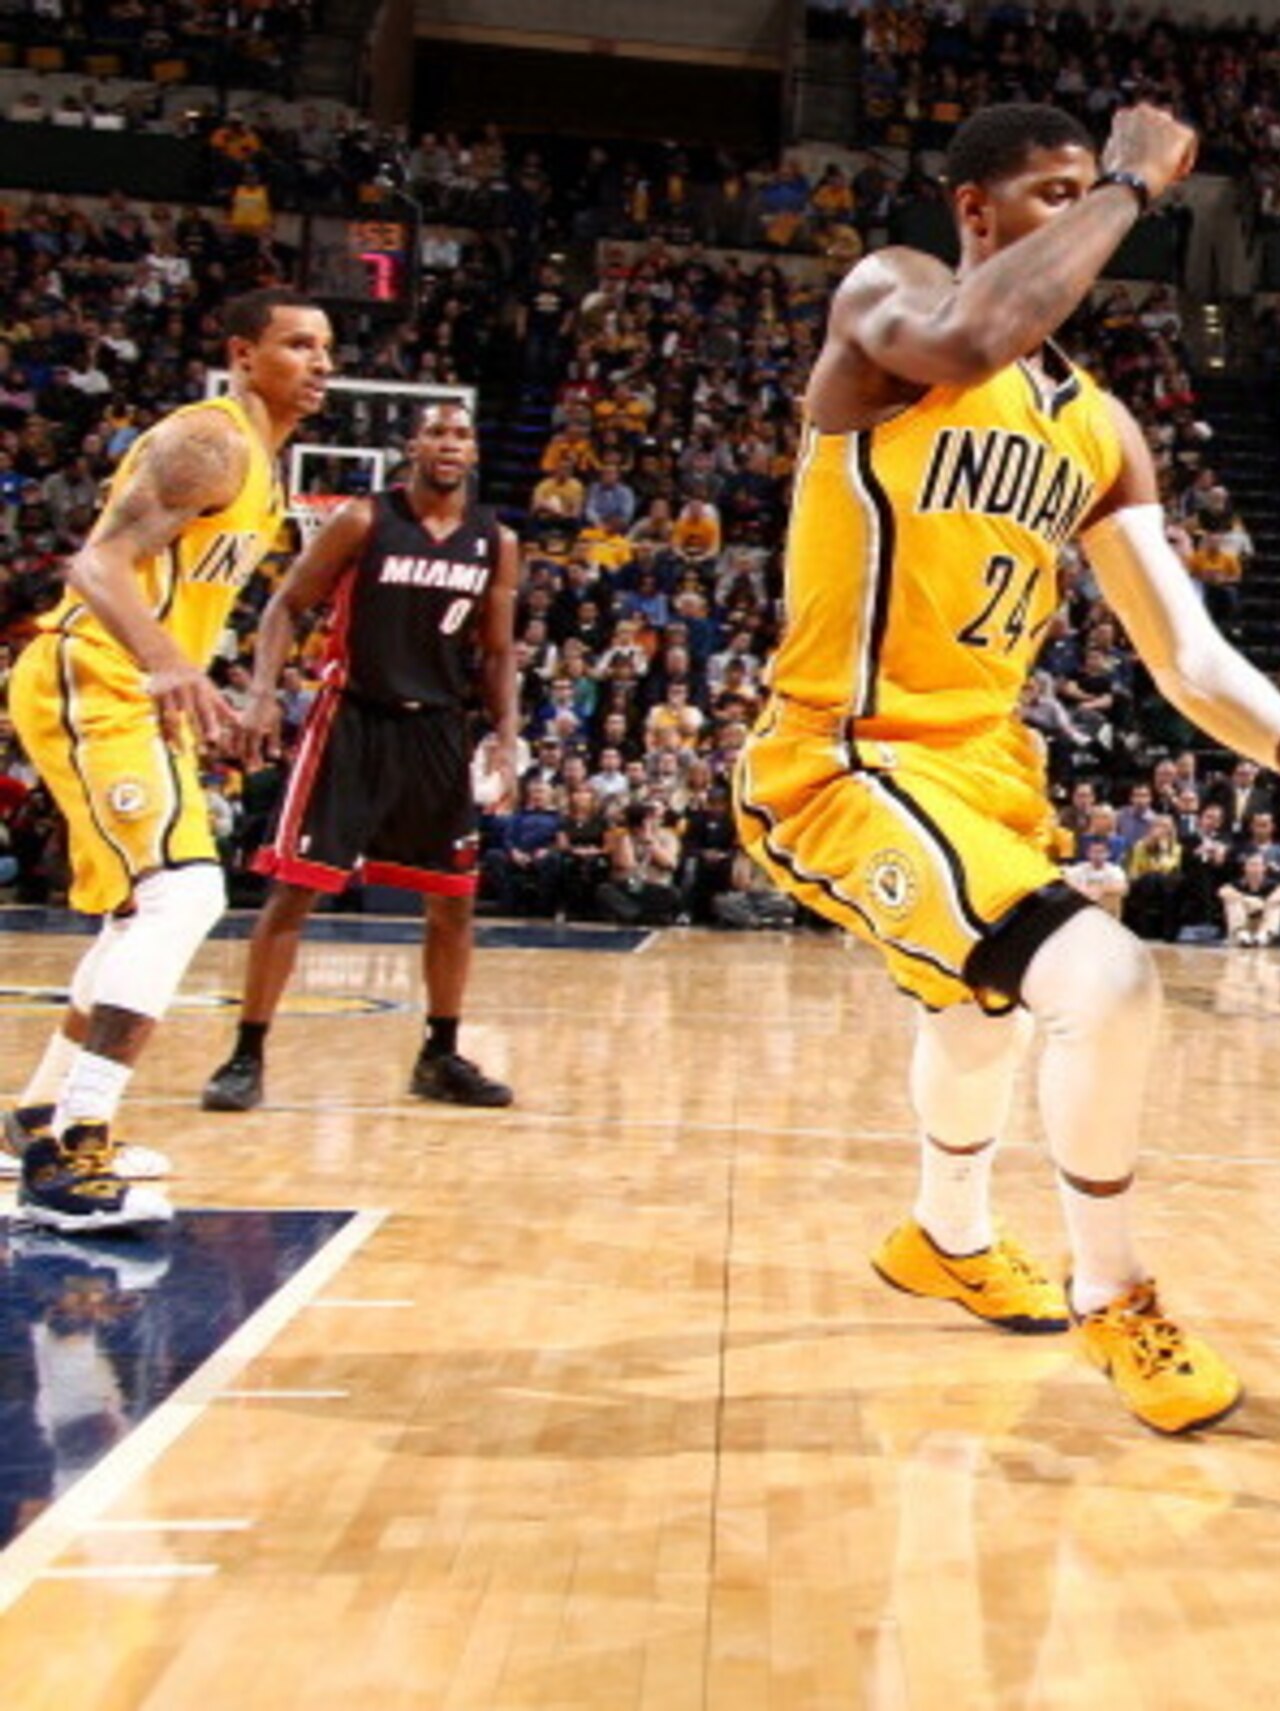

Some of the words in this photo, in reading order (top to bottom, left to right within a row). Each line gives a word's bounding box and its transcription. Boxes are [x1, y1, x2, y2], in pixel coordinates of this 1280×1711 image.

[379, 555, 489, 595] MIAMI
[439, 598, 472, 634] 0
[956, 554, 1052, 655] 24
